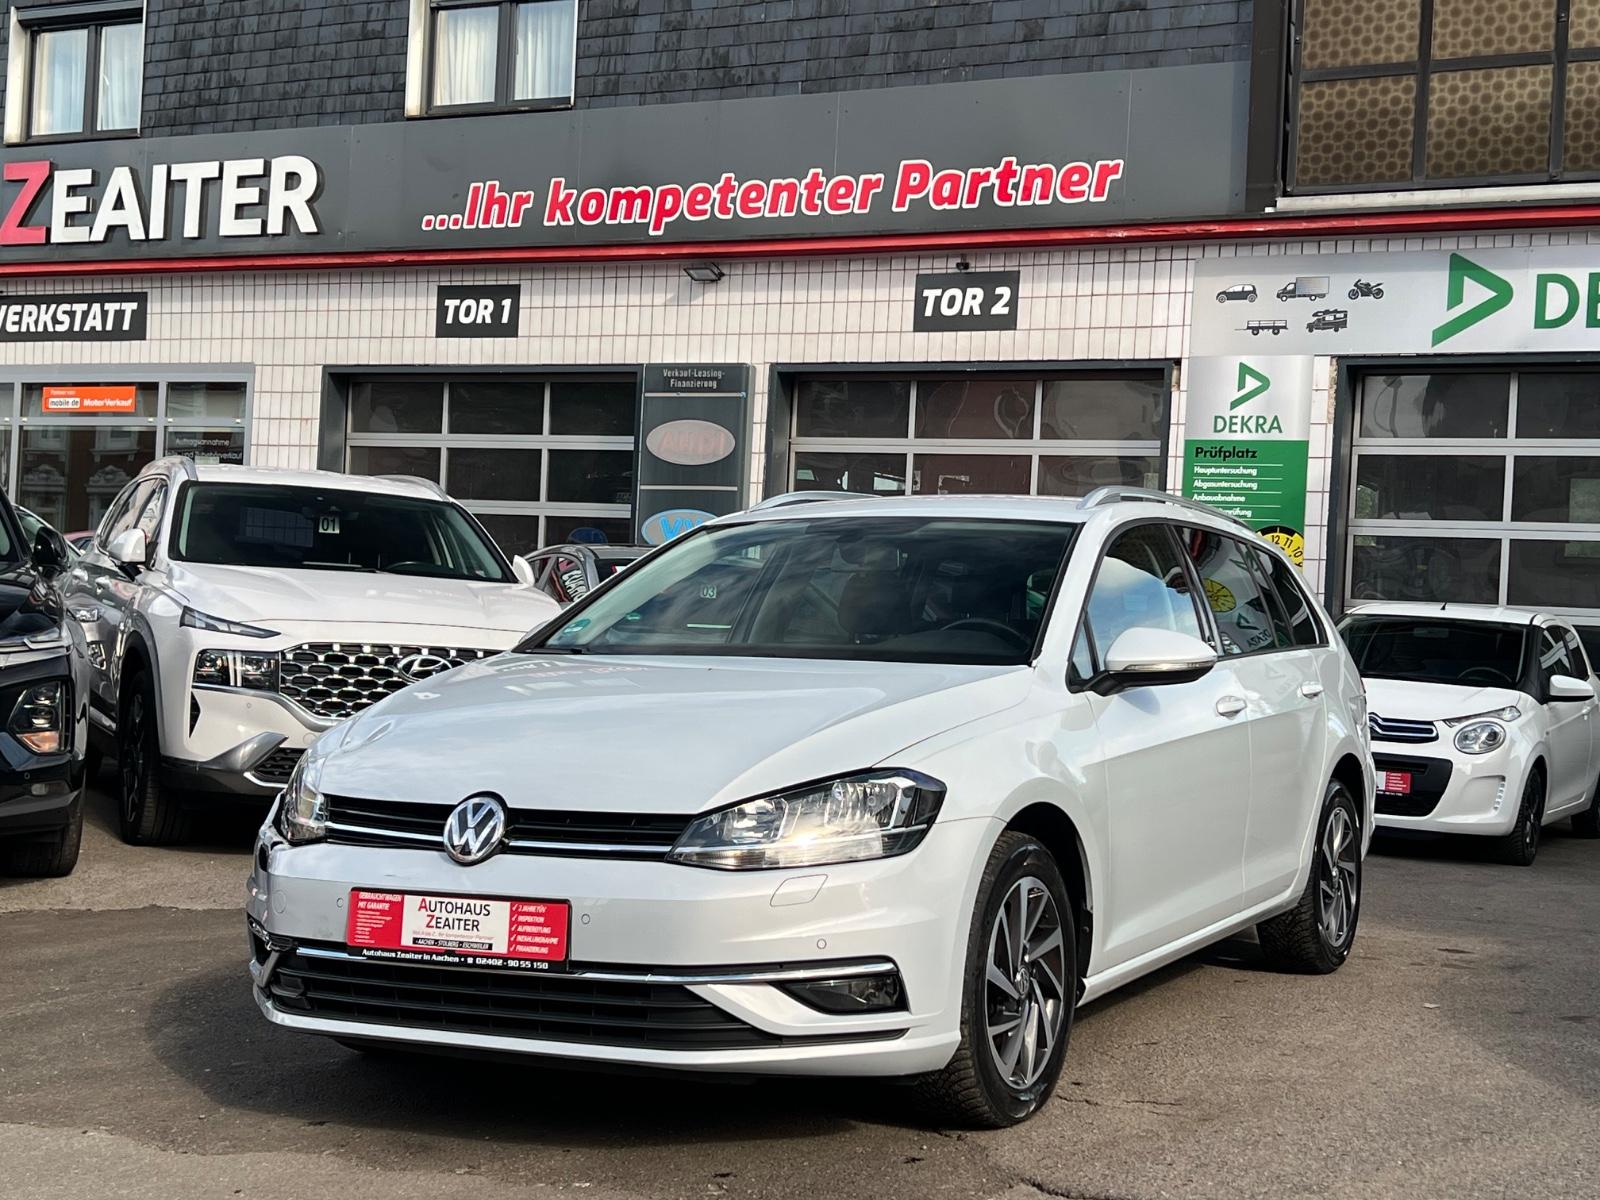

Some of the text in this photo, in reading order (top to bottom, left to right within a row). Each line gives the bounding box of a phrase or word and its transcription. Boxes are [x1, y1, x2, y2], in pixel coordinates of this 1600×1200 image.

[1, 155, 319, 245] ZEAITER
[543, 168, 884, 235] kompetenter
[892, 157, 1124, 212] Partner
[922, 286, 1012, 317] TOR 2
[443, 299, 512, 324] TOR 1
[670, 378, 718, 389] Finanzierung
[1213, 414, 1283, 434] DEKRA
[1195, 445, 1258, 461] Prüfplatz
[1194, 466, 1258, 476] Hauptuntersuchung
[1193, 480, 1258, 490] Abgasuntersuchung
[1192, 494, 1245, 502] Anbauabnahme
[321, 517, 336, 532] 01
[1271, 535, 1281, 545] 12
[1284, 537, 1294, 549] 11
[418, 898, 491, 917] AUTOHAUS
[426, 914, 480, 932] ZEAITER
[362, 948, 396, 957] Autohaus
[396, 951, 422, 960] Zeaiter
[431, 954, 459, 962] Aachen
[475, 957, 503, 966] 02402
[519, 960, 531, 968] 55
